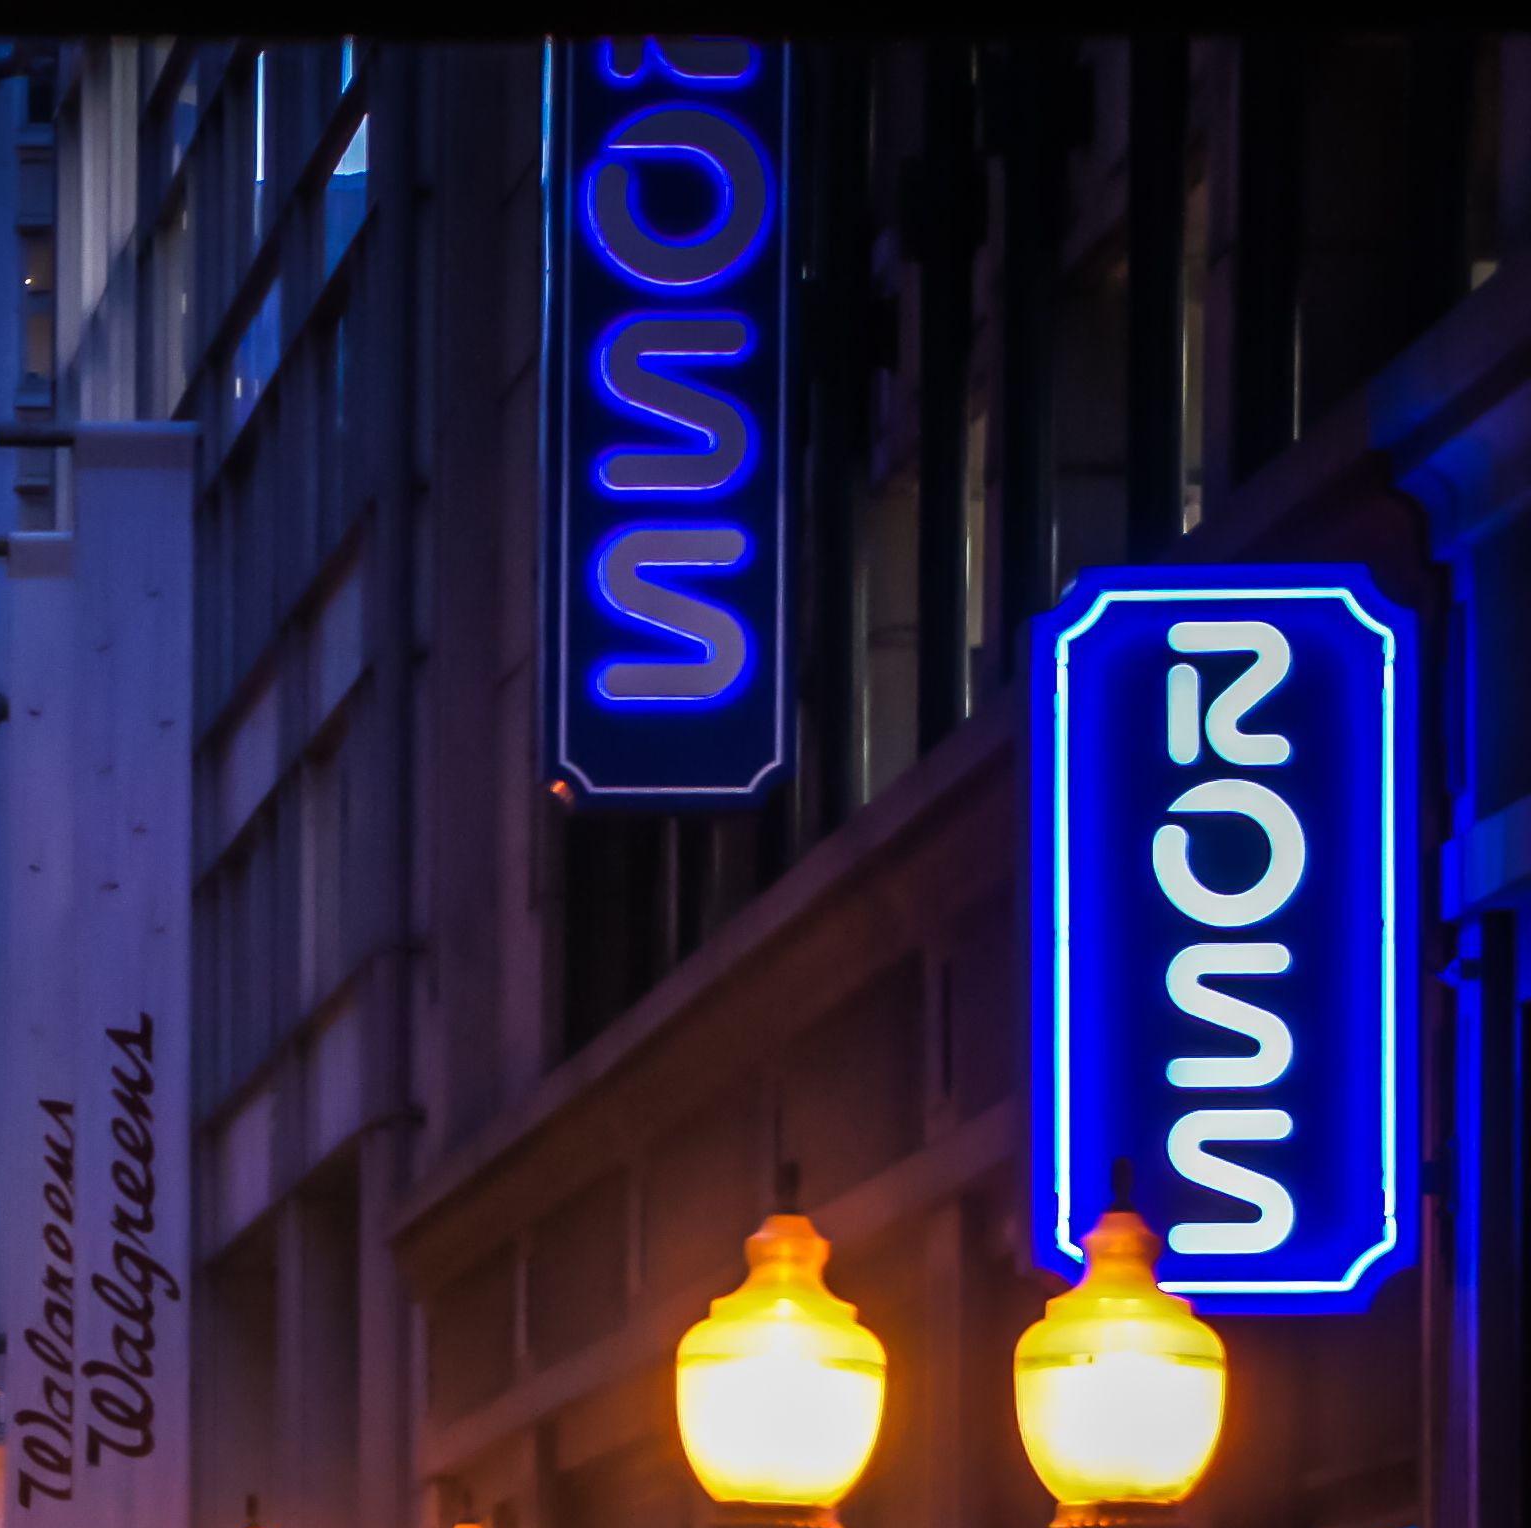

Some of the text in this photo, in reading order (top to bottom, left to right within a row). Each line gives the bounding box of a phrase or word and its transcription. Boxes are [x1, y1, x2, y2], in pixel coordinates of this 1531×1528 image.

[591, 36, 771, 702] OSS
[83, 1012, 182, 1467] Walgreens
[1152, 621, 1306, 1255] ROSS
